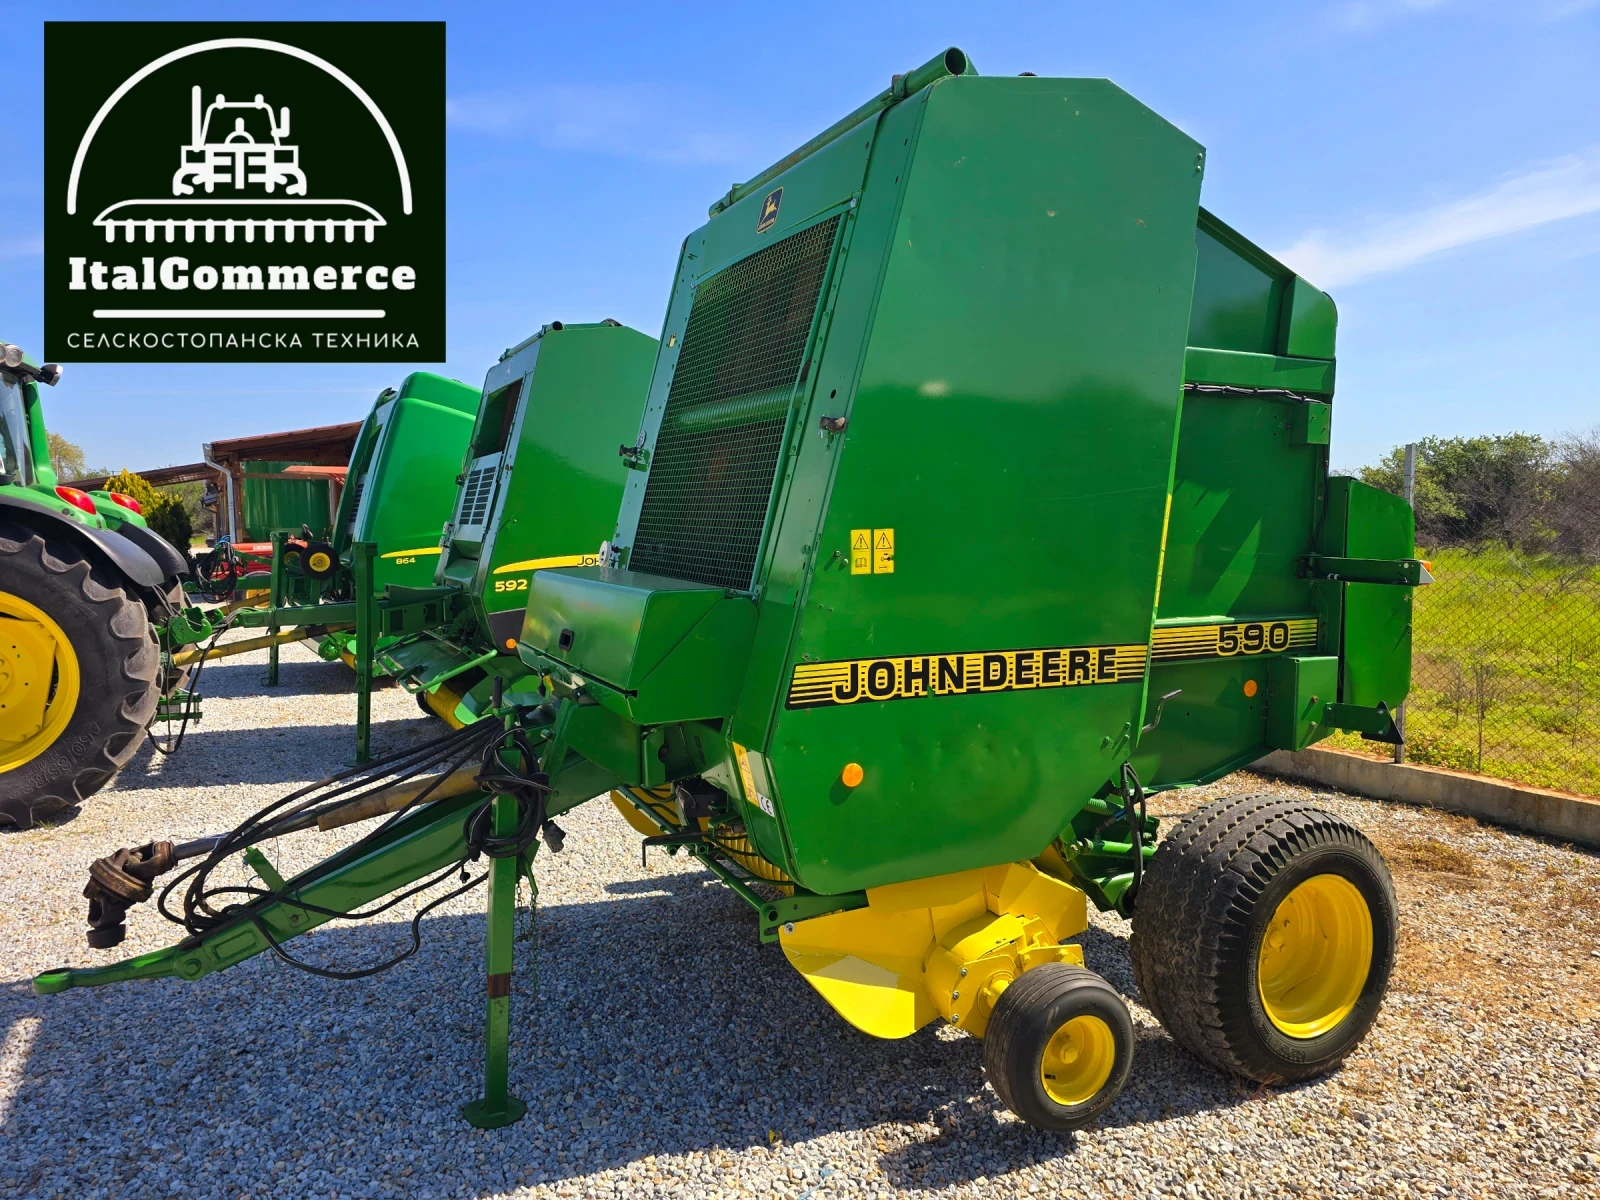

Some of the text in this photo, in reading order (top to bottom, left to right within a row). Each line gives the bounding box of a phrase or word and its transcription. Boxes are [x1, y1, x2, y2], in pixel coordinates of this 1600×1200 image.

[395, 557, 416, 565] 864
[577, 555, 600, 567] JOH
[494, 578, 528, 593] 592
[1217, 622, 1290, 656] 590
[833, 646, 1117, 703] JOHN DEERE
